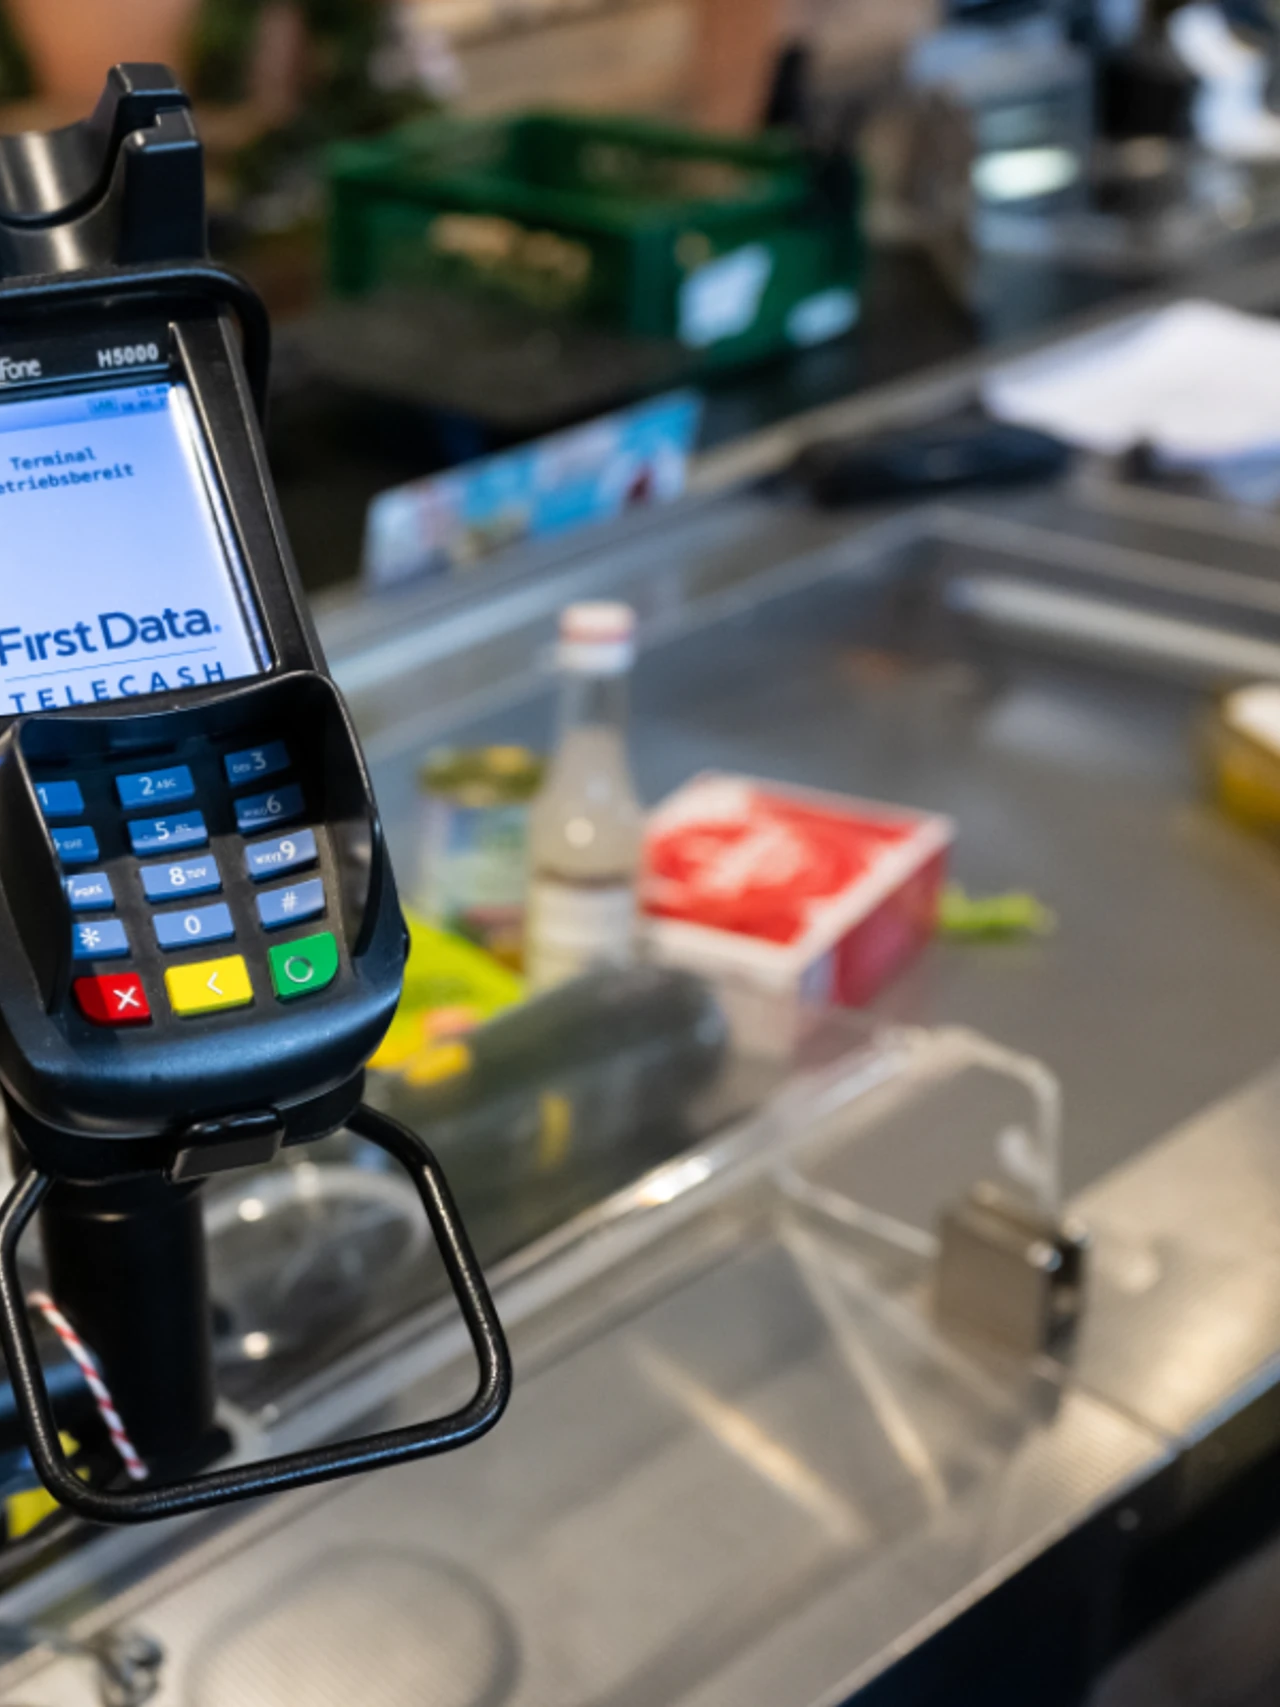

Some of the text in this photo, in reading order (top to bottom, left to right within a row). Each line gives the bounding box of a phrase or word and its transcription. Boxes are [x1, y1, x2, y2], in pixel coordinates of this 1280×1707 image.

[97, 344, 159, 368] H5000
[9, 447, 97, 471] Terminal
[8, 661, 226, 714] TELECASH
[251, 751, 267, 770] 3
[138, 776, 155, 796] 2
[266, 794, 282, 814] 6
[154, 821, 170, 840] 5
[279, 840, 296, 860] 9
[169, 866, 186, 886] 8
[184, 914, 202, 935] 0
